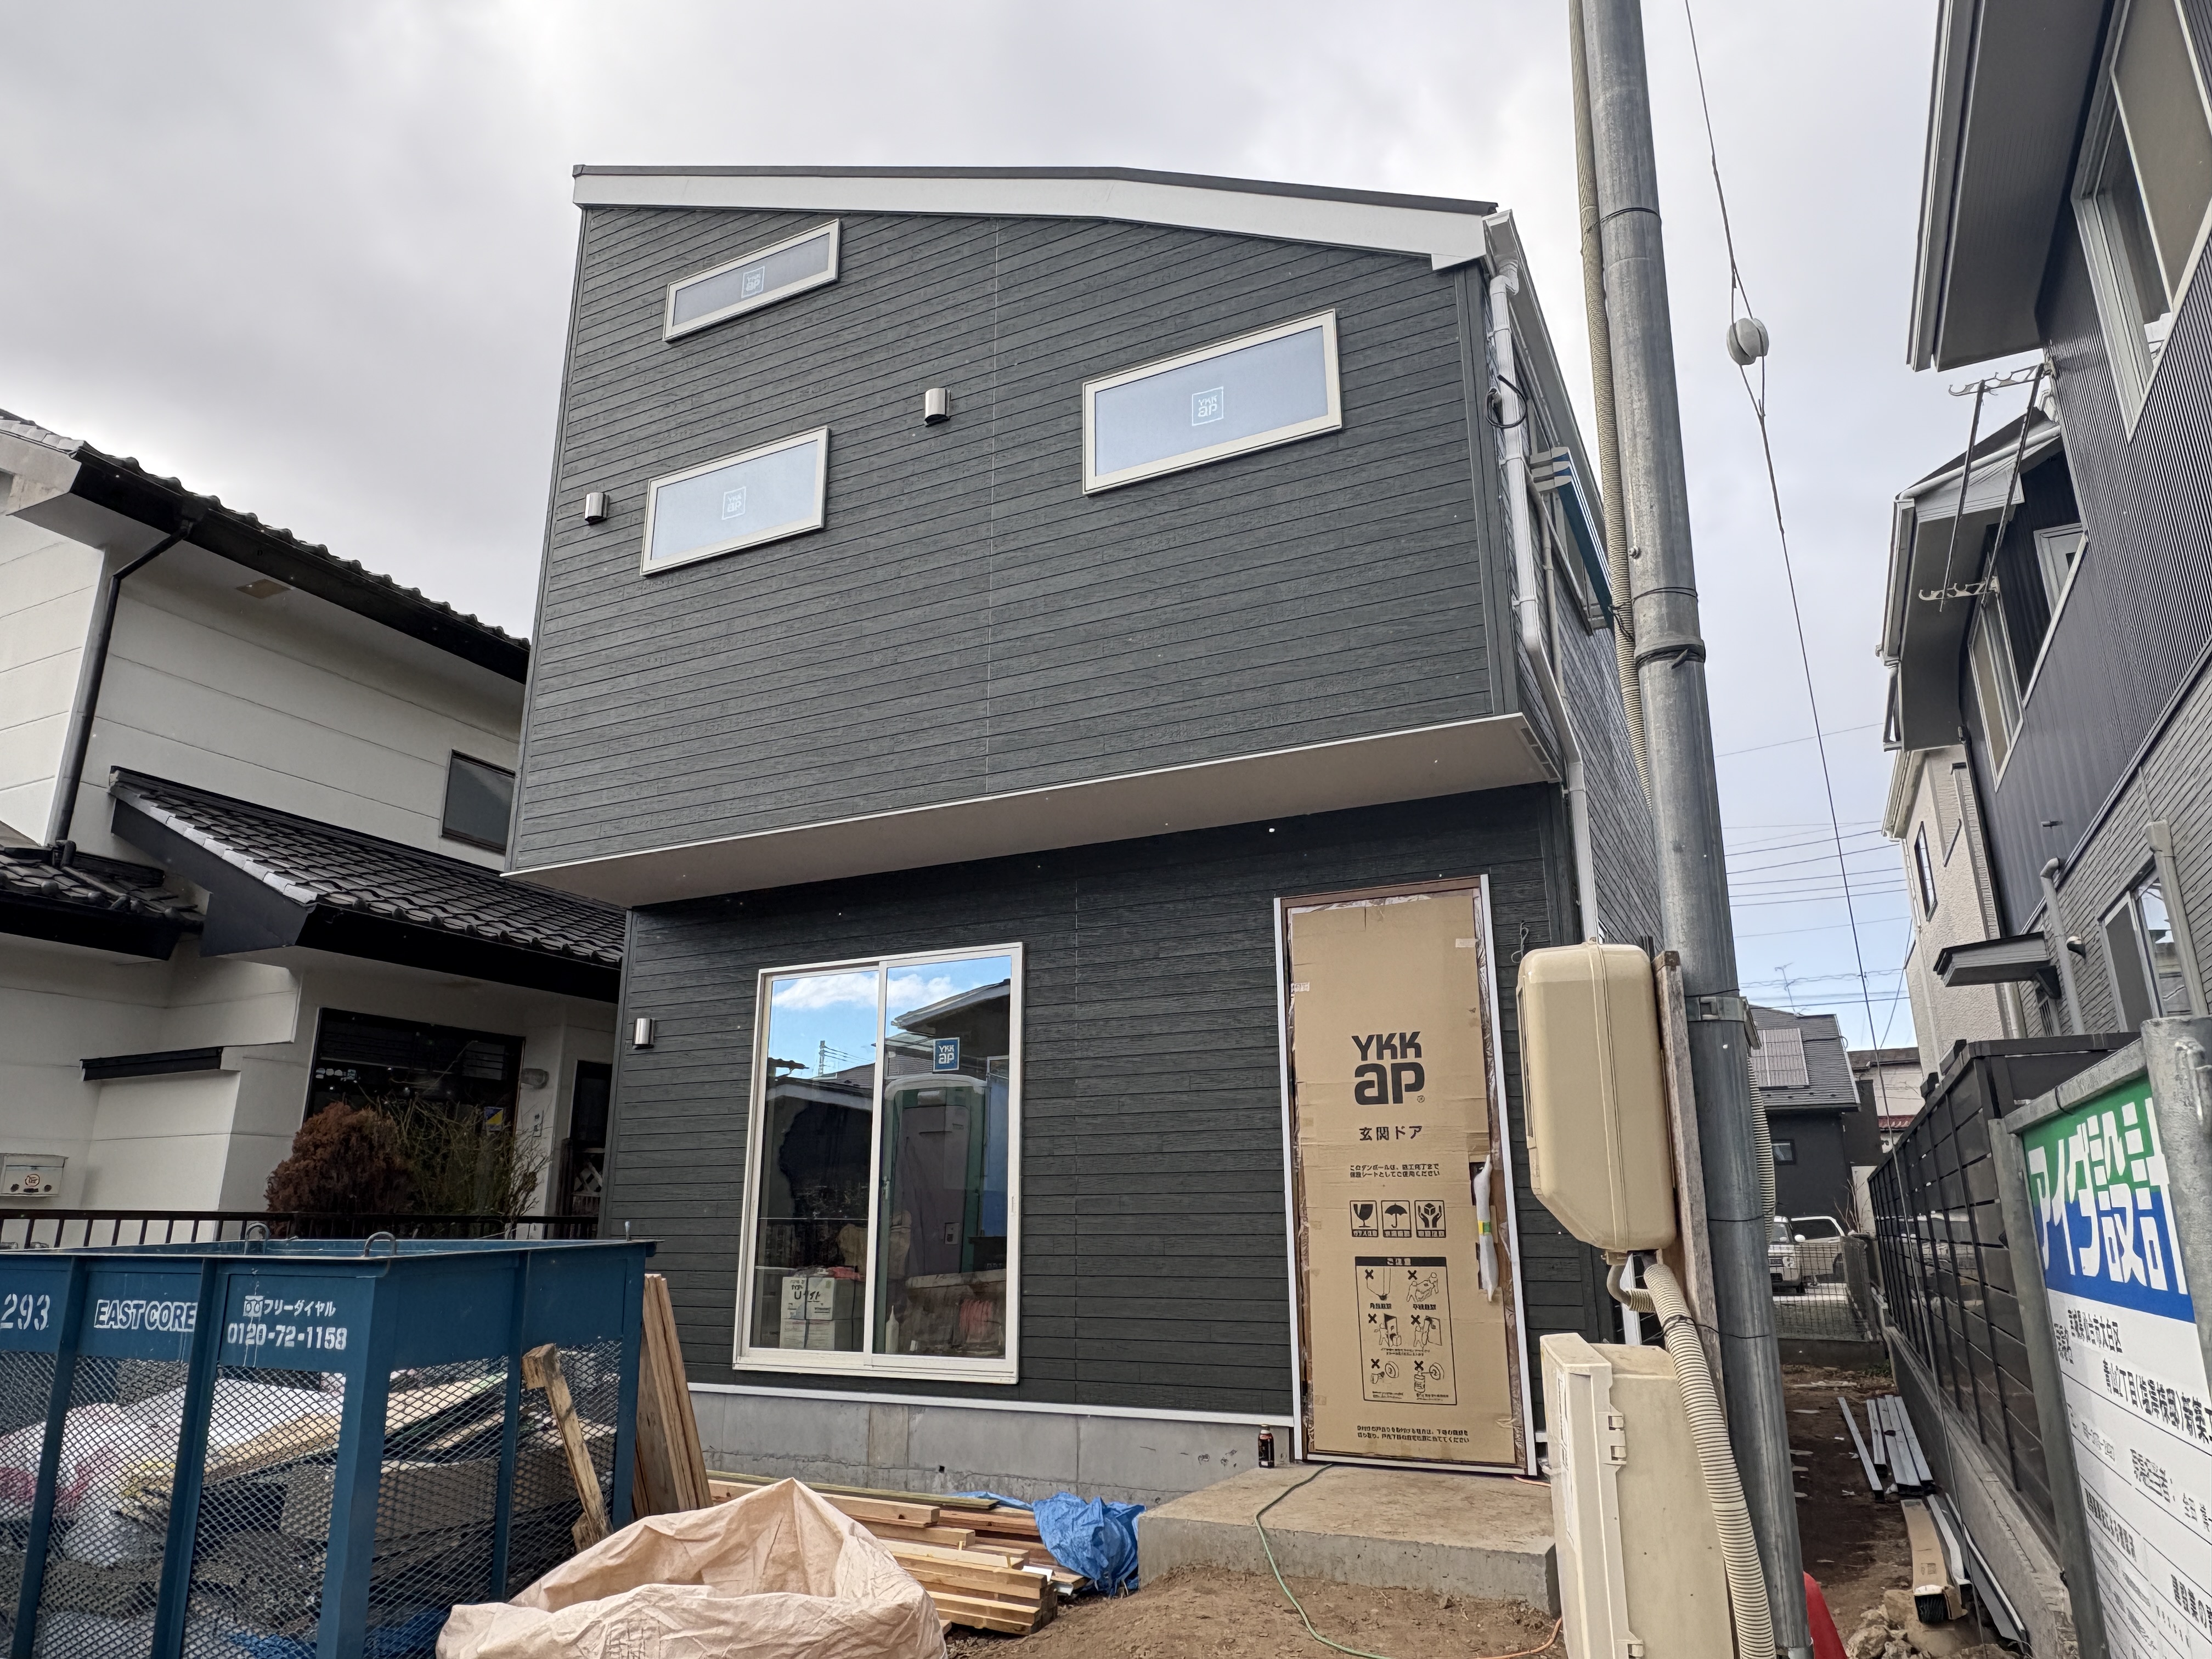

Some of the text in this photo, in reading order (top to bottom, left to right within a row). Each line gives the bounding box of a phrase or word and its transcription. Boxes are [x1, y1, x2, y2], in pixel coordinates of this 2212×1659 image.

[1198, 395, 1218, 407] YKK
[1198, 403, 1218, 417] ap
[1351, 1031, 1422, 1061] YKK
[938, 1052, 955, 1064] ap
[1354, 1062, 1425, 1105] ap
[1359, 1126, 1423, 1141] 玄関ドア
[0, 1293, 50, 1331] 293
[264, 1299, 336, 1317] フリーダイヤル
[228, 1323, 348, 1350] 0120-72-1158
